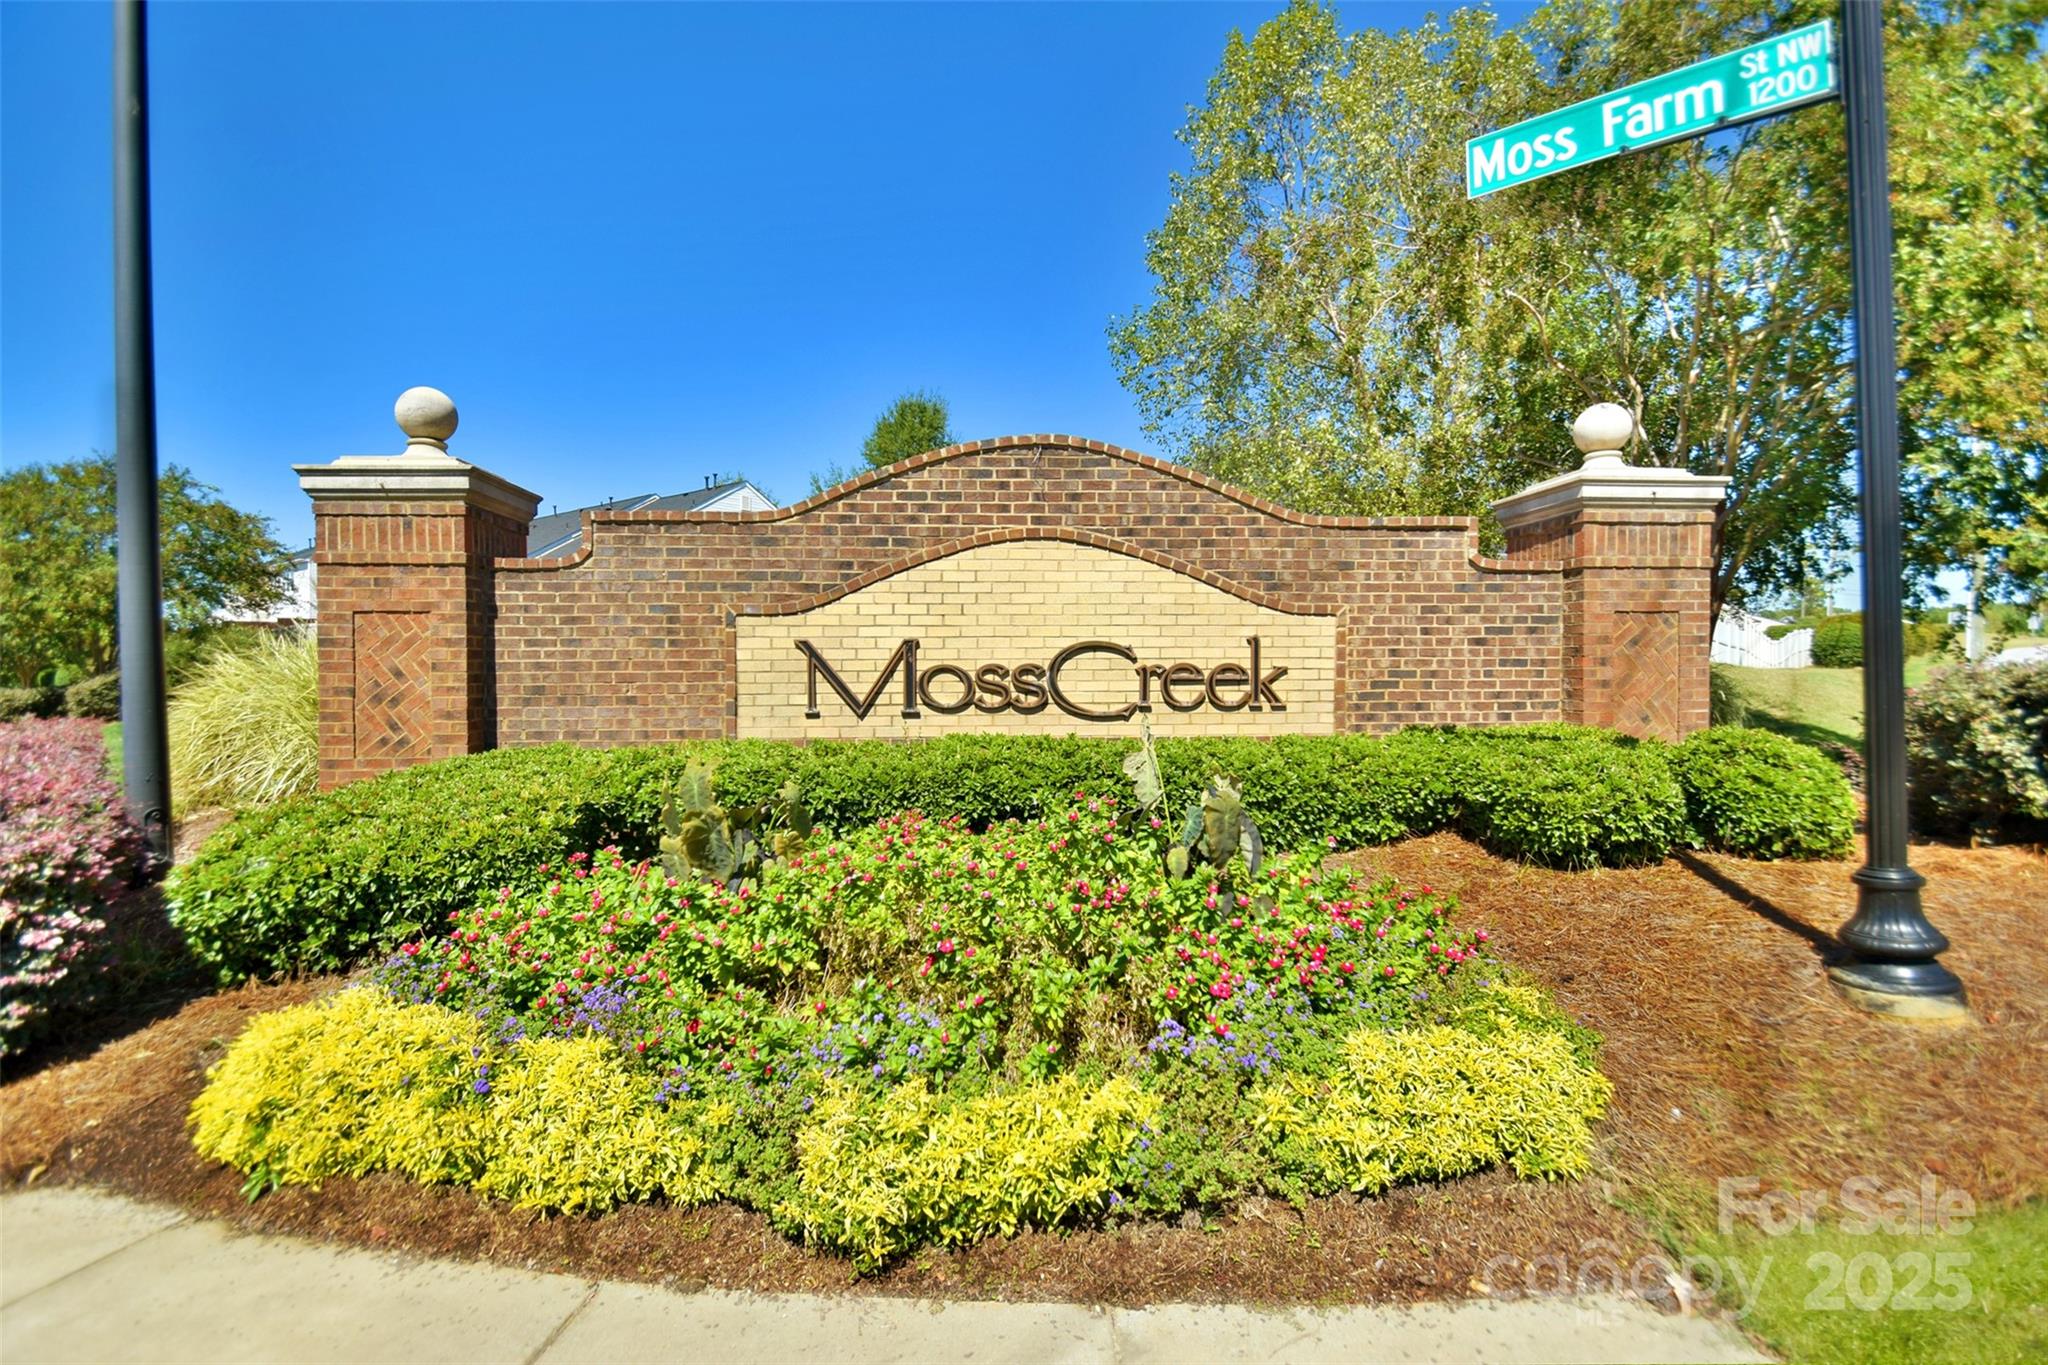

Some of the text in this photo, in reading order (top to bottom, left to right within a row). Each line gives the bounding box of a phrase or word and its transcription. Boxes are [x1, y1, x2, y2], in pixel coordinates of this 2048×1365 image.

[1739, 30, 1822, 79] St NW
[1748, 64, 1817, 106] 1200
[1473, 79, 1724, 188] Moss Farm
[794, 634, 1288, 722] MossCreek
